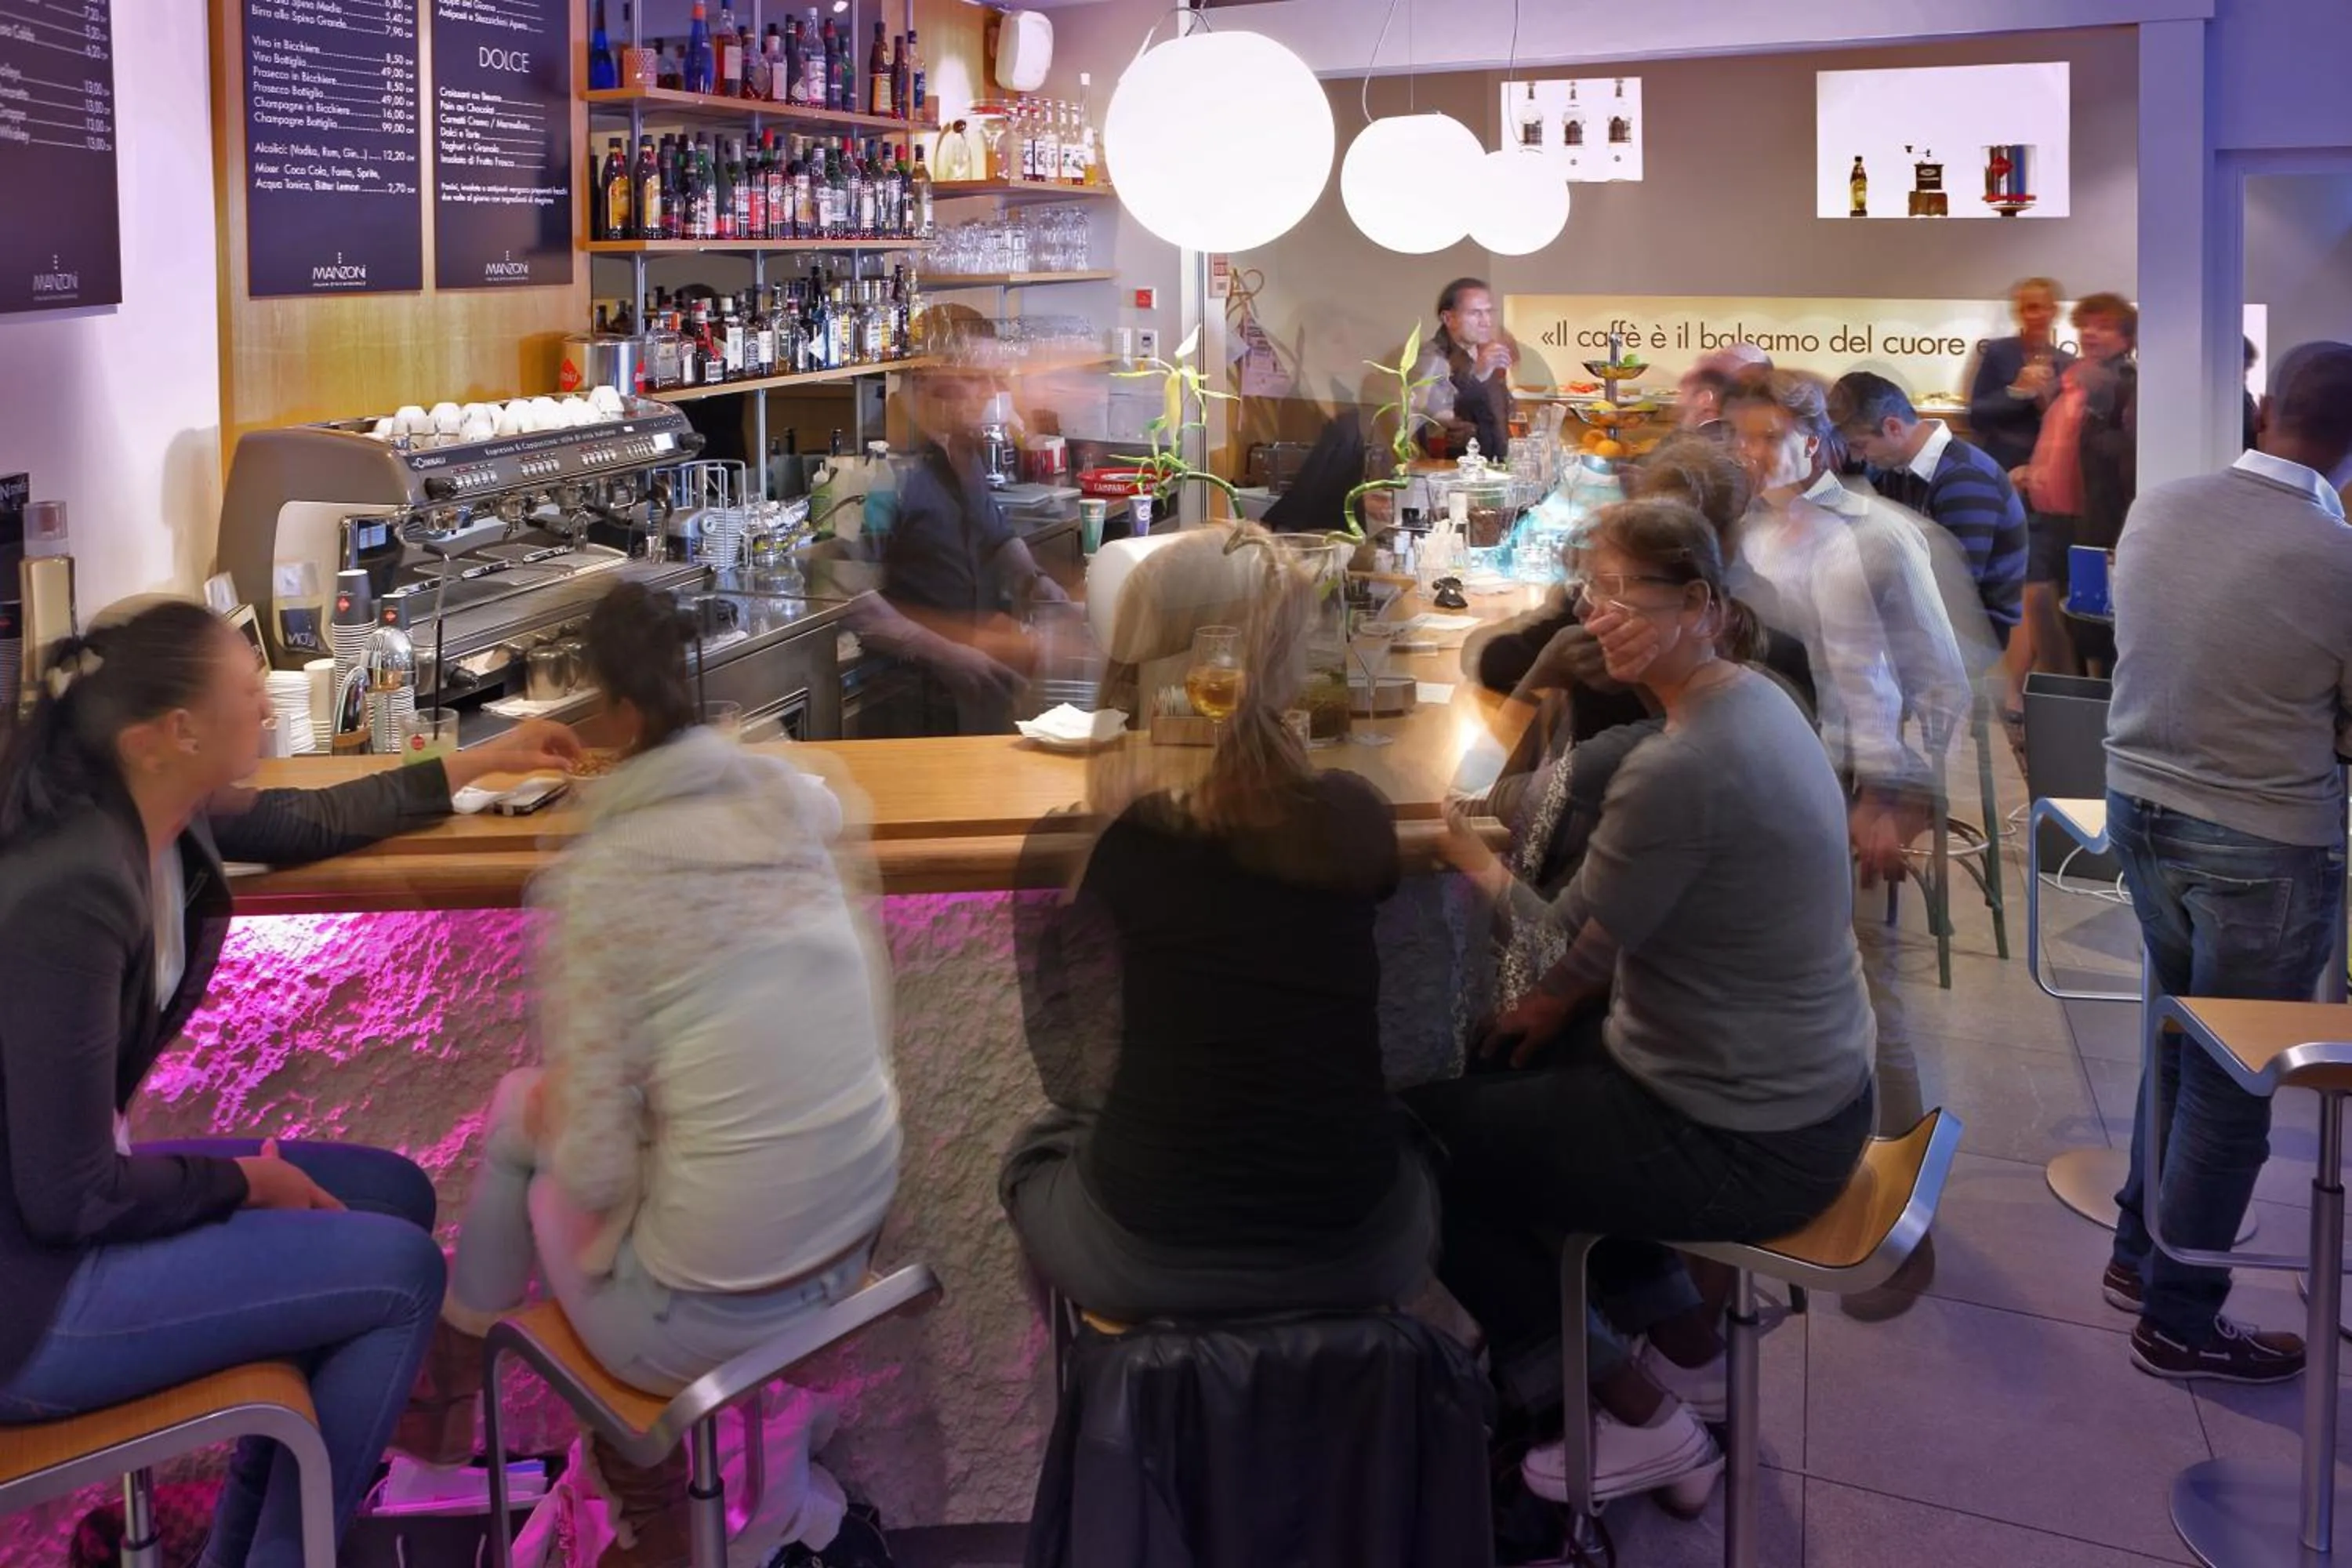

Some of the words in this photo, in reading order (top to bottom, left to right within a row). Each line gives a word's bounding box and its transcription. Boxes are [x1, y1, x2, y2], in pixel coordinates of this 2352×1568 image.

[316, 15, 347, 29] Grande
[385, 24, 404, 38] 7,90
[252, 34, 272, 48] Vino
[274, 38, 281, 49] in
[283, 39, 321, 54] Bicchiere
[252, 50, 272, 64] Vino
[274, 53, 307, 68] Bottiglia
[479, 45, 530, 73] DOLCE
[253, 65, 289, 80] Prosecco
[302, 71, 337, 85] Bicchiere
[253, 81, 290, 95] Prosecco
[292, 85, 324, 100] Bottiglia
[253, 96, 304, 114] Champagne
[316, 102, 350, 115] Bicchiere
[383, 107, 405, 121] 16,00
[253, 111, 304, 128] Champagne
[307, 115, 338, 131] Bottiglia
[382, 122, 405, 134] 99,00
[383, 150, 405, 162] 12,20
[284, 164, 307, 175] Coca
[255, 178, 283, 193] Acqua
[1577, 319, 1642, 348] caffè
[1650, 324, 1667, 348] è
[1677, 321, 1689, 349] il
[1700, 321, 1820, 353] balsamo
[1830, 324, 1872, 354] del
[1882, 336, 1965, 356] cuore
